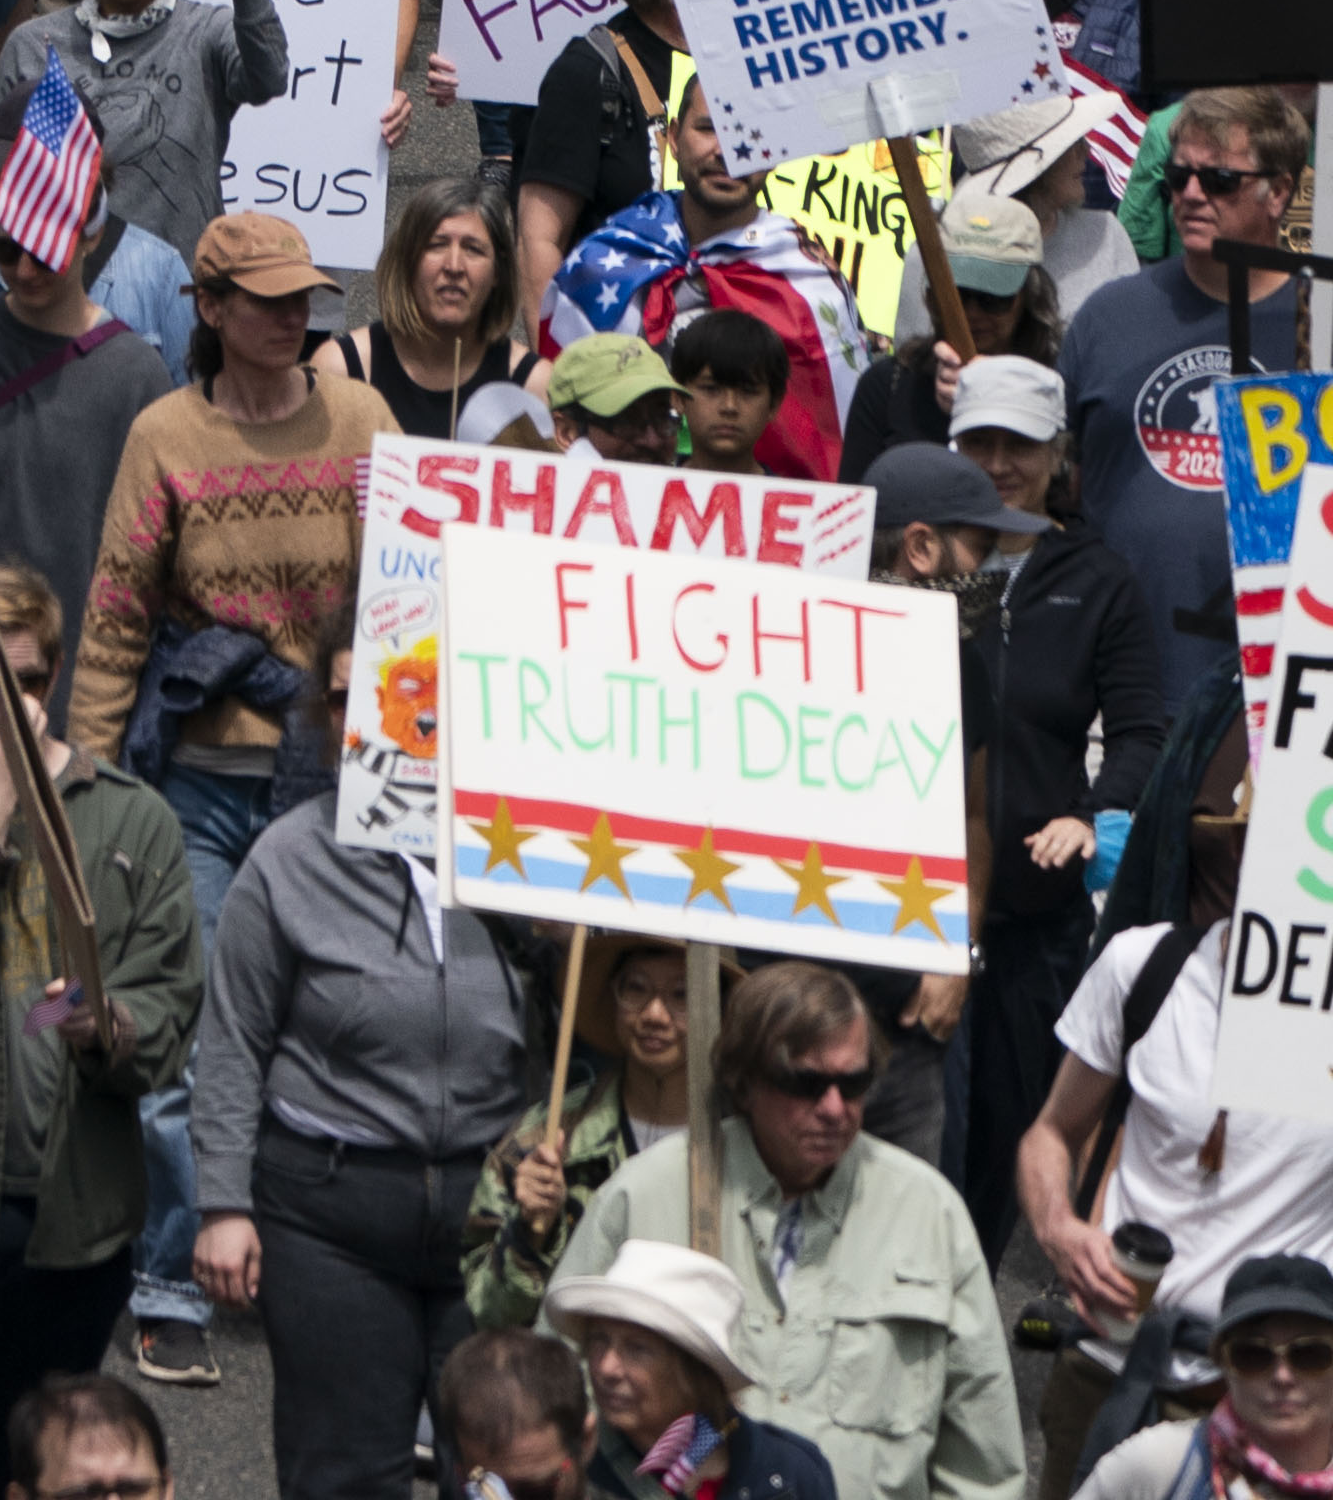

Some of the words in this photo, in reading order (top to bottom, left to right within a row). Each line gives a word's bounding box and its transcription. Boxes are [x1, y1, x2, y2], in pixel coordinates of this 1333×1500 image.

[744, 12, 968, 89] HISTORY.
[555, 560, 908, 693] FIGHT
[458, 652, 701, 770] TRUTH
[736, 691, 956, 798] DECAY
